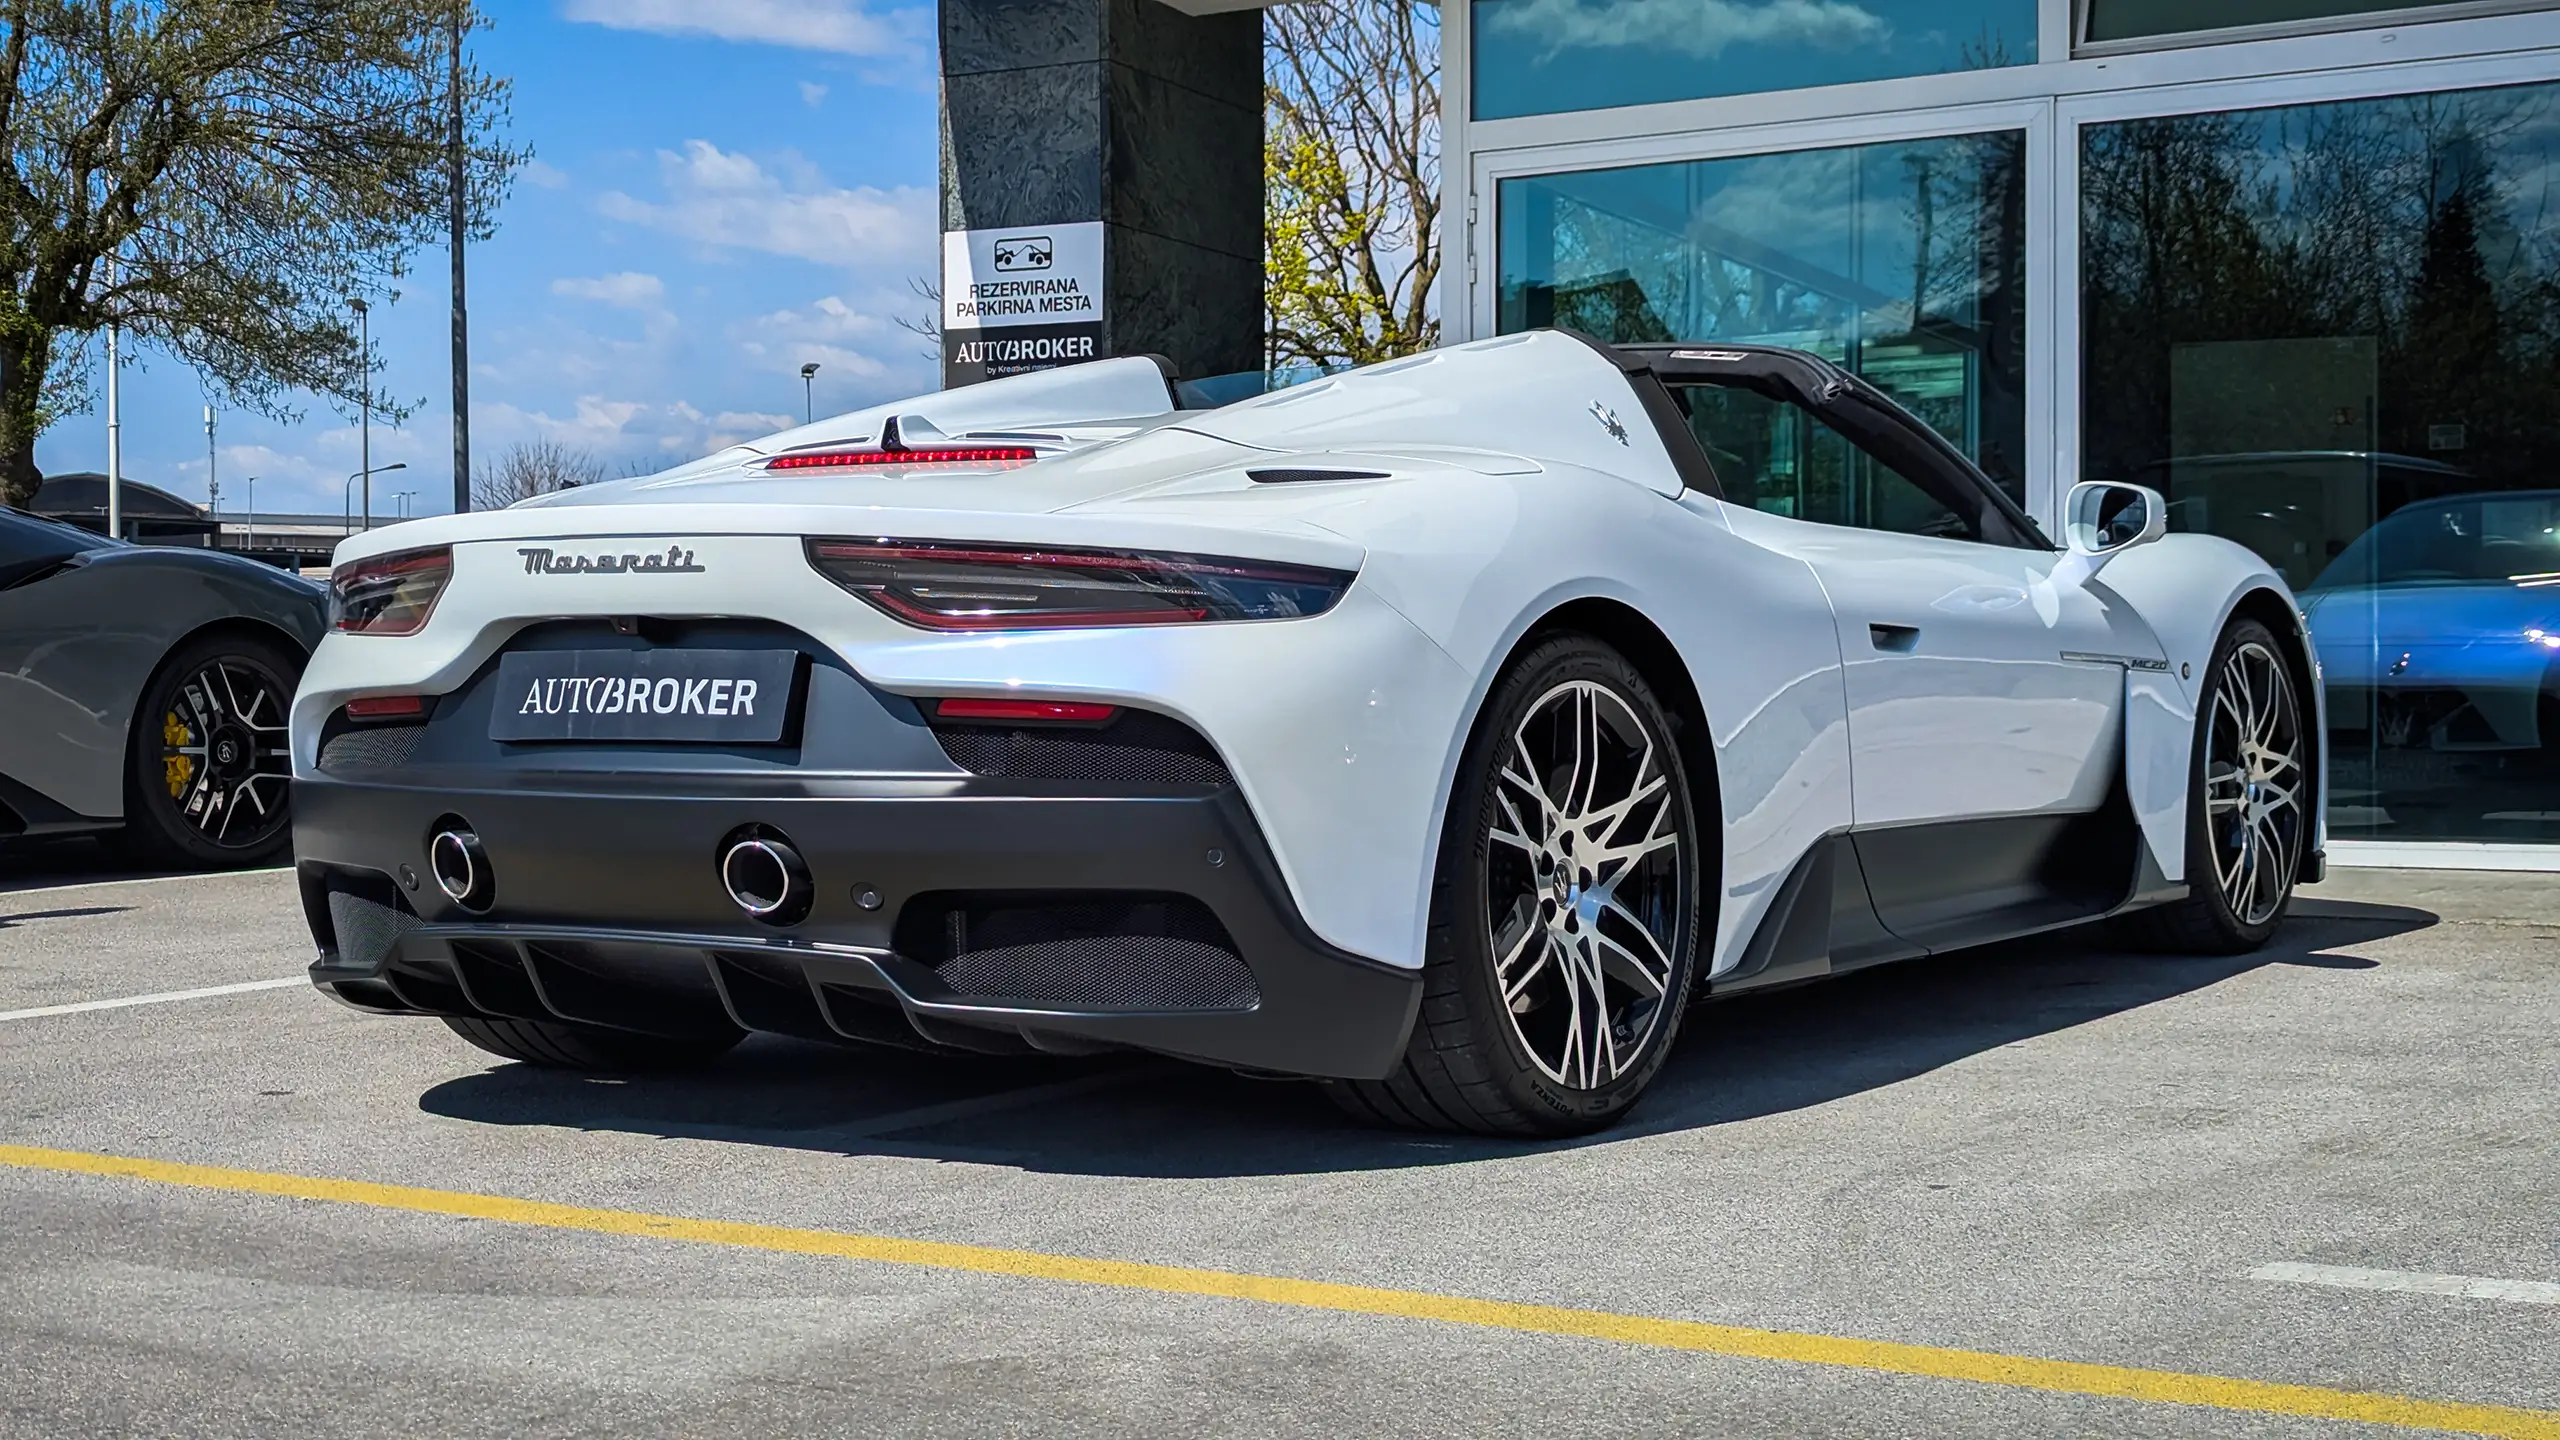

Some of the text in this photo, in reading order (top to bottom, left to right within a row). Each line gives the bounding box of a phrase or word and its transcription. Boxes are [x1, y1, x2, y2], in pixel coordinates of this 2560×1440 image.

[969, 278, 1079, 299] REZERVIRANA
[956, 295, 1092, 317] PARKIRNA MESTA
[986, 365, 997, 375] by
[516, 545, 706, 575] Maserati
[2130, 658, 2168, 671] MC20
[1473, 726, 1509, 860] BRIDGESTONE
[1530, 1079, 1574, 1117] POTENZA
